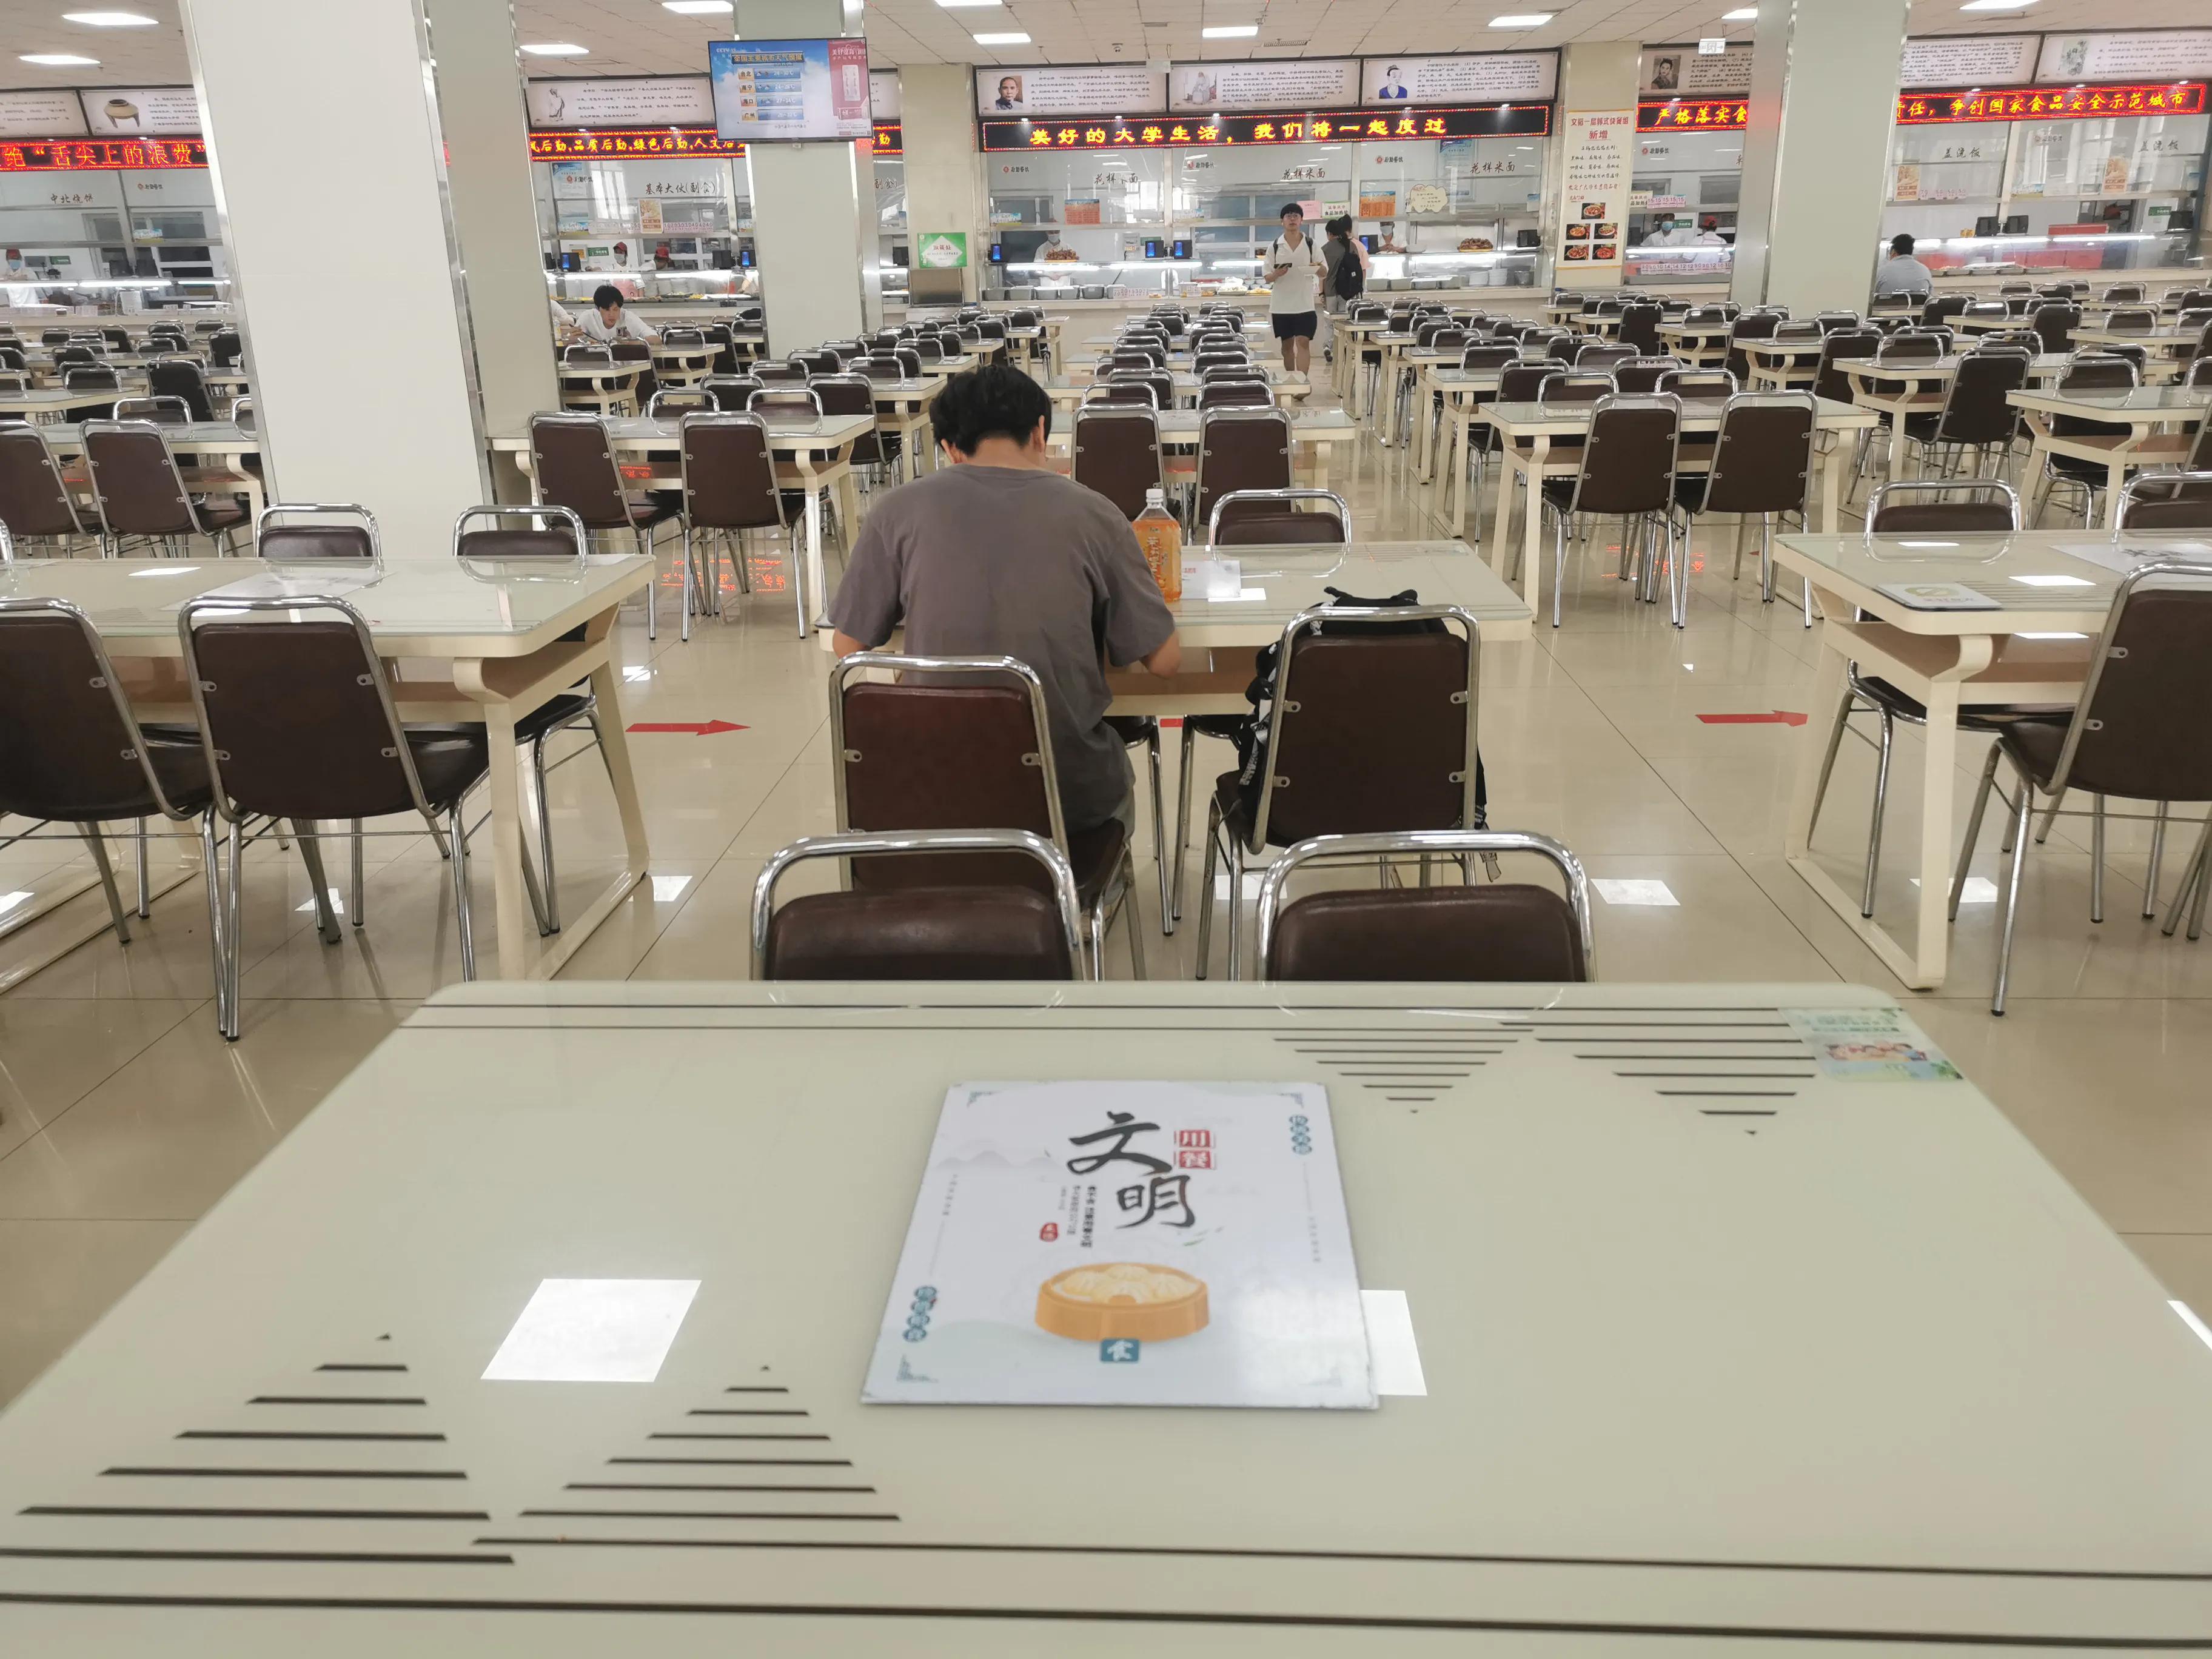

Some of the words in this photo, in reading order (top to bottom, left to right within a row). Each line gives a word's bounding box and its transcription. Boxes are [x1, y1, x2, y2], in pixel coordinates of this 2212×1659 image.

[1589, 130, 1608, 139] 新增
[1470, 160, 1515, 174] 花样米面
[1094, 173, 1139, 185] 花样面
[1066, 1111, 1196, 1229] 文明
